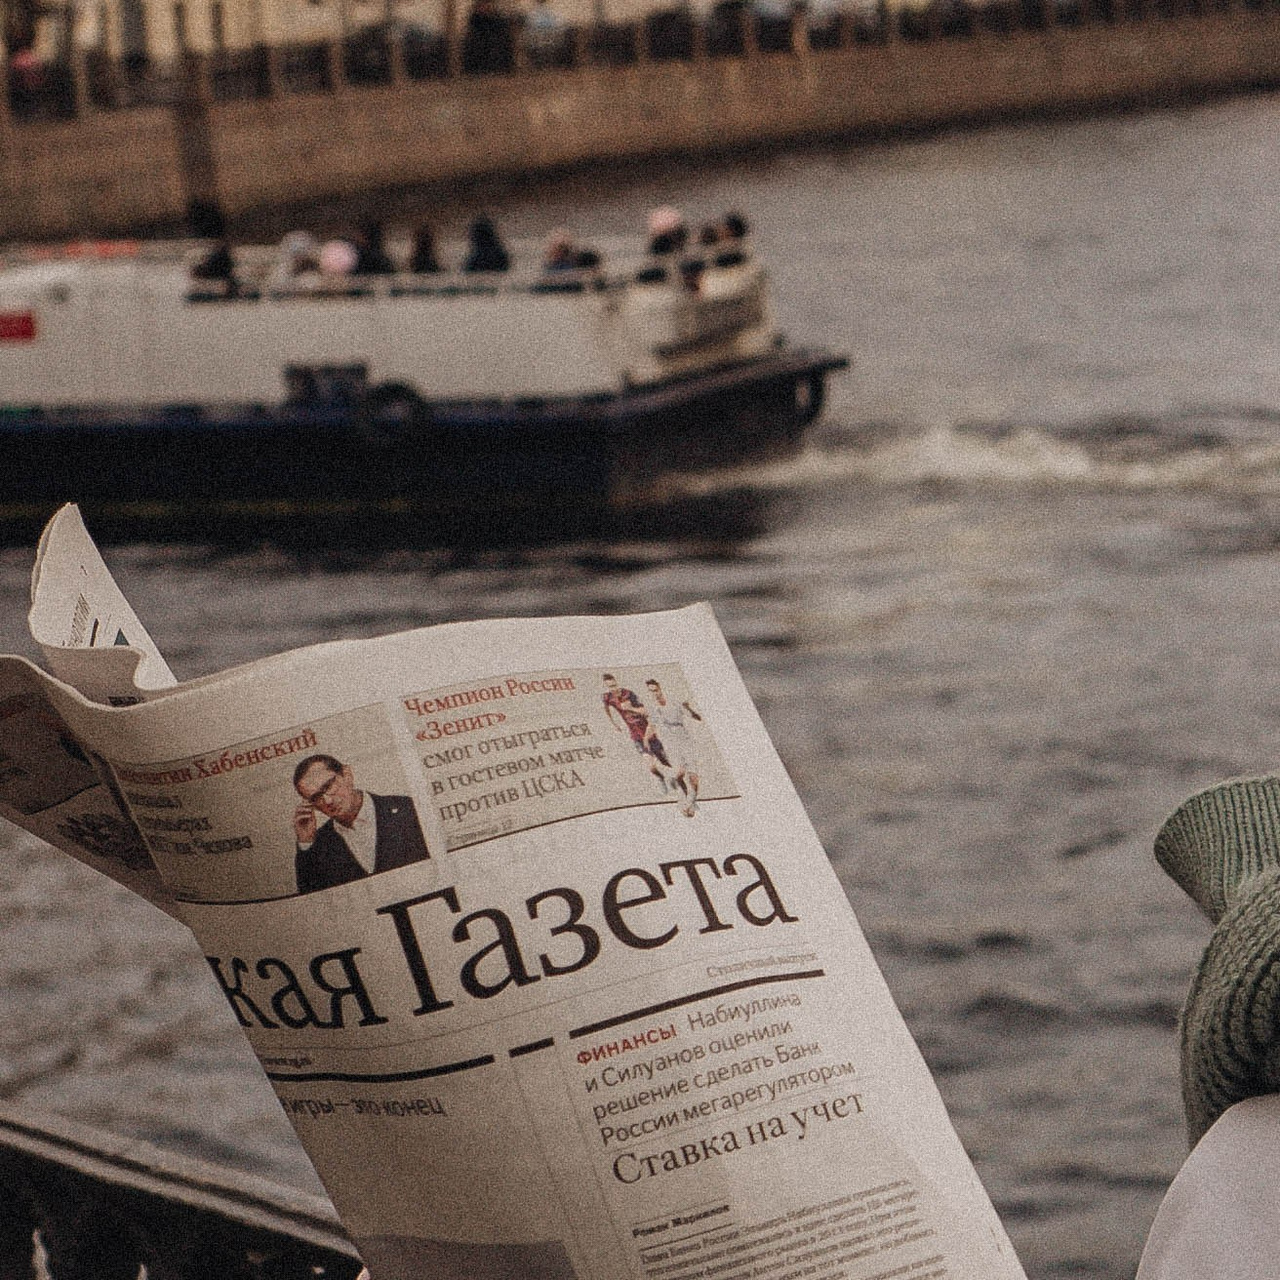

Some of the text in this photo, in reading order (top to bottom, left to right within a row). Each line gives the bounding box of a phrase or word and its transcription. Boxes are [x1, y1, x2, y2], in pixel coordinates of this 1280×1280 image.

[404, 677, 576, 717] Чемпион России
[415, 712, 507, 742] «Зенит»
[193, 727, 318, 779] Хабенский
[422, 723, 592, 770] смог отыграться
[431, 746, 607, 796] в гостевом матче
[439, 769, 586, 822] против ЦСКА
[376, 851, 799, 1018] Газета
[576, 991, 802, 1066] ФИНАНСЫ Набиуллина
[585, 1020, 793, 1093] и Силуанов оценили
[593, 1039, 822, 1125] решение сделать Банк
[600, 1061, 856, 1147] России мегарегулятором
[612, 1092, 865, 1185] Ставка на учет
